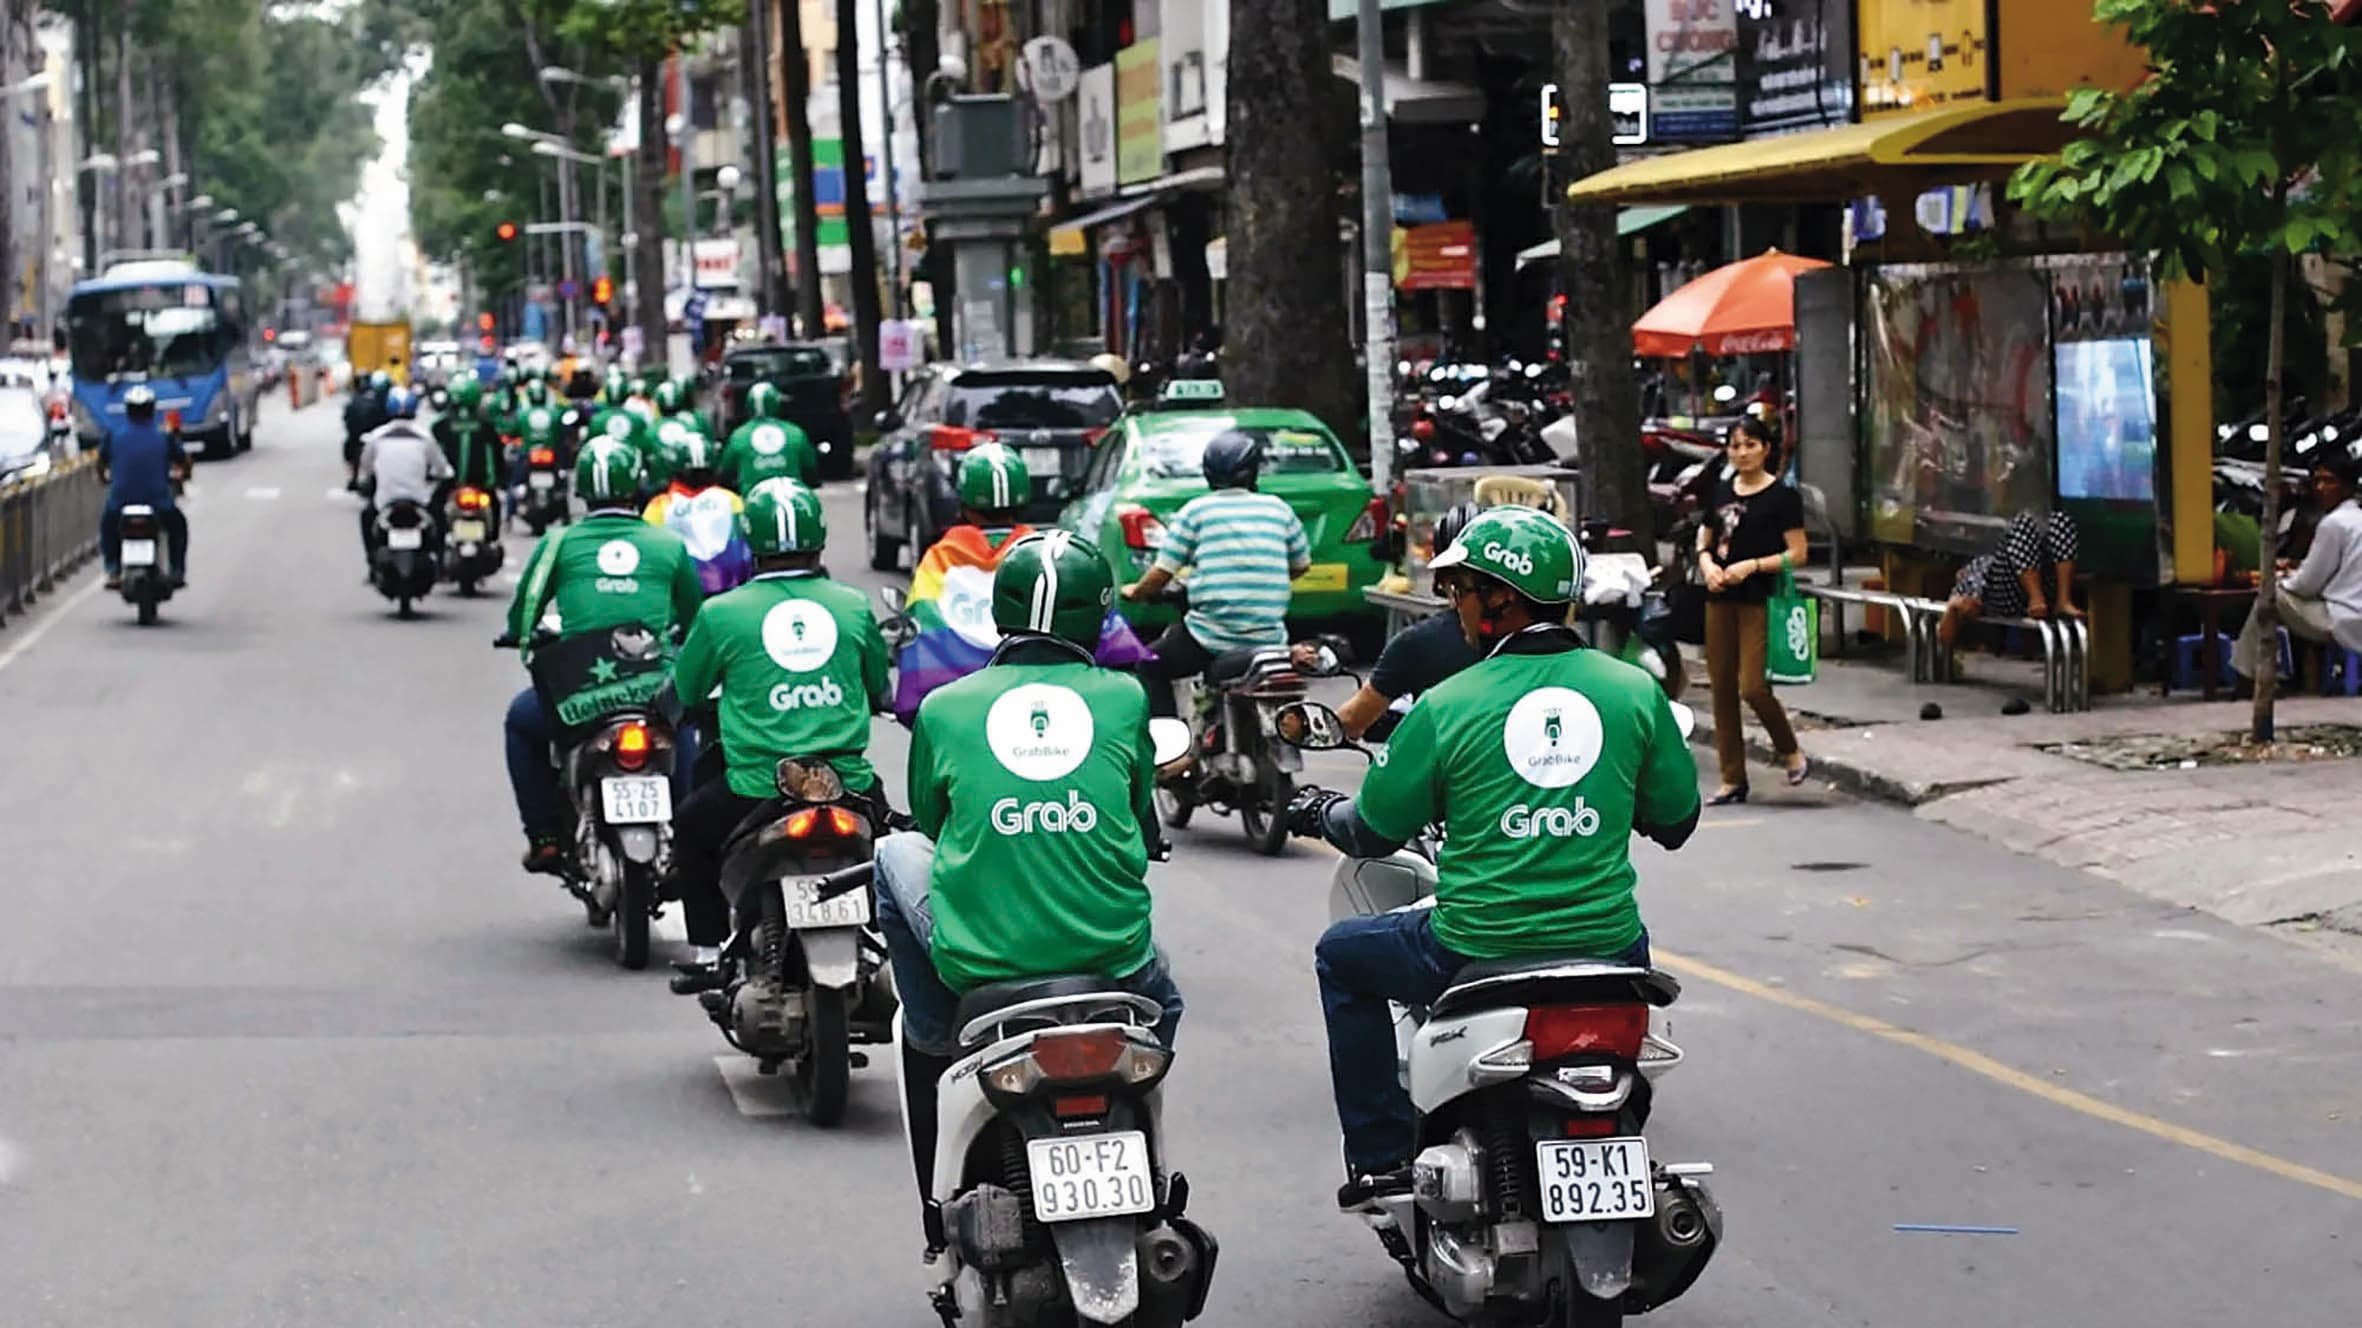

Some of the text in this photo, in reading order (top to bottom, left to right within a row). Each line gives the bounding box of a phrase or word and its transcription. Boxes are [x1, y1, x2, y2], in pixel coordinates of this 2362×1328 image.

[1483, 541, 1533, 576] Grab
[594, 577, 640, 594] Grab
[769, 675, 843, 711] Grab
[1012, 746, 1070, 758] GrabBike
[1528, 754, 1581, 767] GrabBike
[991, 789, 1097, 836] Grab
[1500, 796, 1600, 838] Grab
[1555, 1145, 1629, 1178] 59-K1
[1042, 1175, 1145, 1213] 930.30
[1549, 1181, 1646, 1215] 892.35
